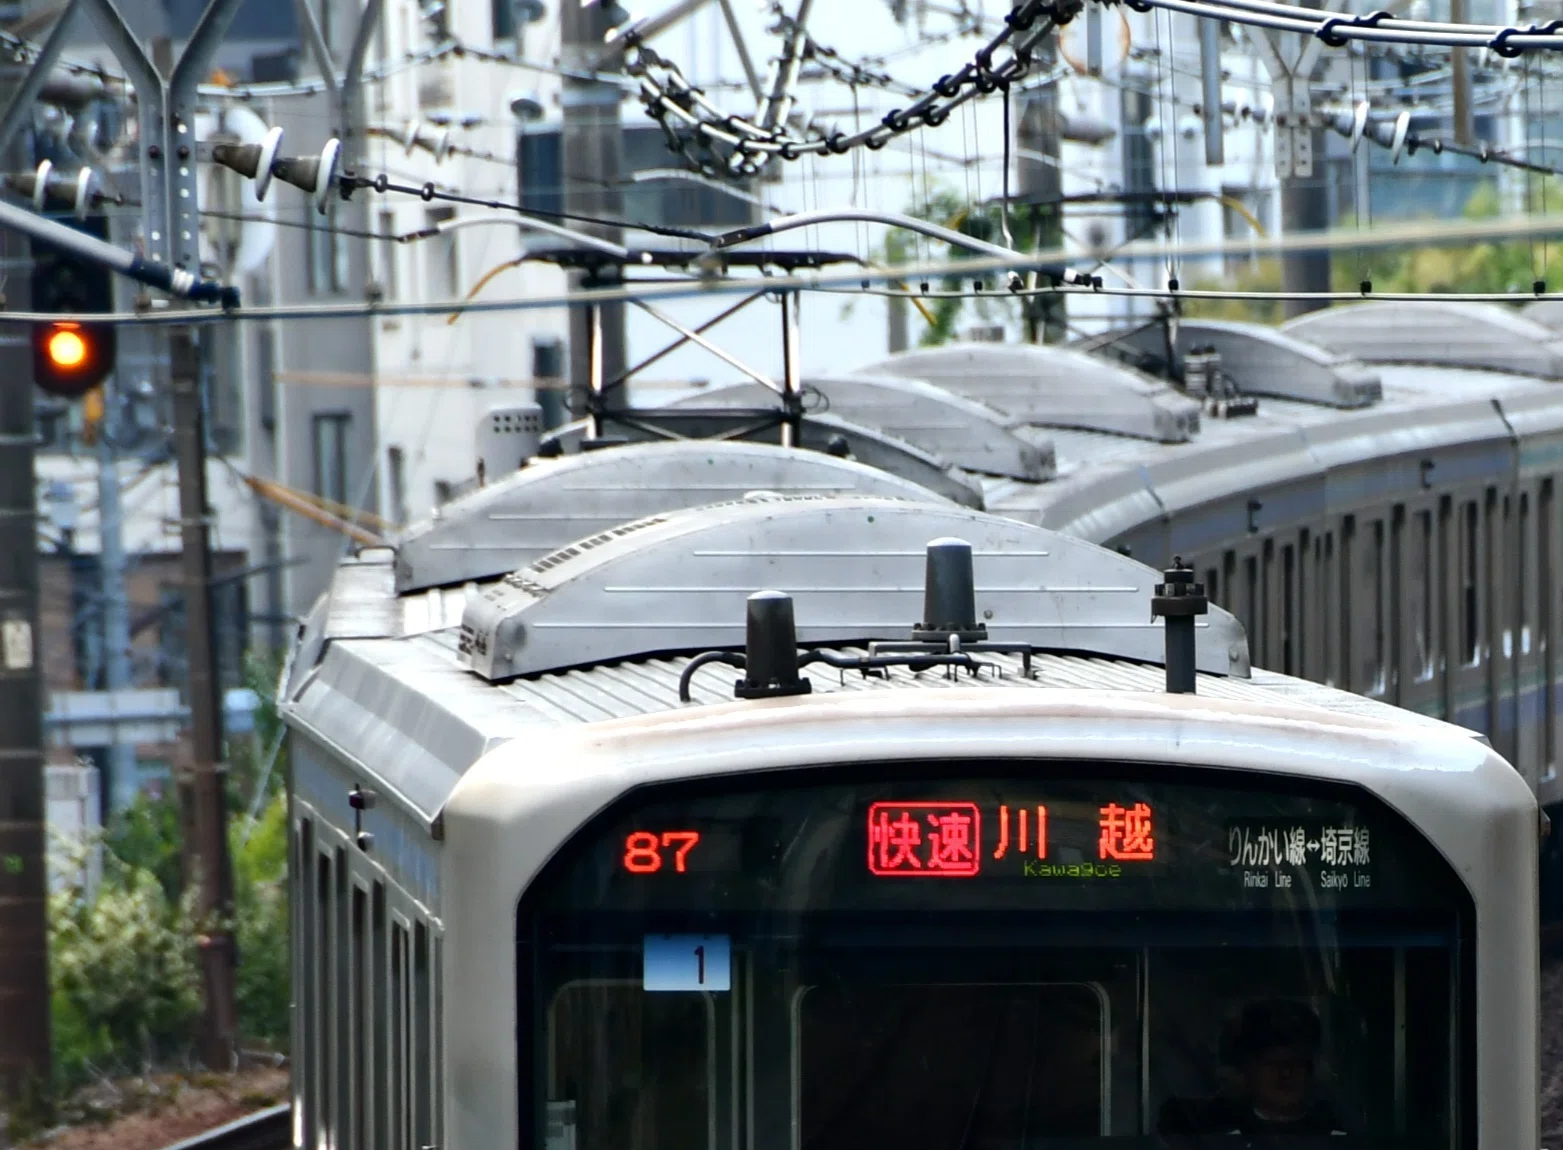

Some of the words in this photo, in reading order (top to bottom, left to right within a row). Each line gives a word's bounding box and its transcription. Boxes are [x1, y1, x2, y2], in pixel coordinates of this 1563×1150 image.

[623, 831, 700, 873] 87
[873, 811, 973, 869] 快速
[1023, 860, 1122, 877] Kawagoe
[1244, 870, 1269, 888] Rinkai
[1274, 870, 1292, 888] Line
[1353, 871, 1371, 888] Line
[694, 945, 705, 984] 1
